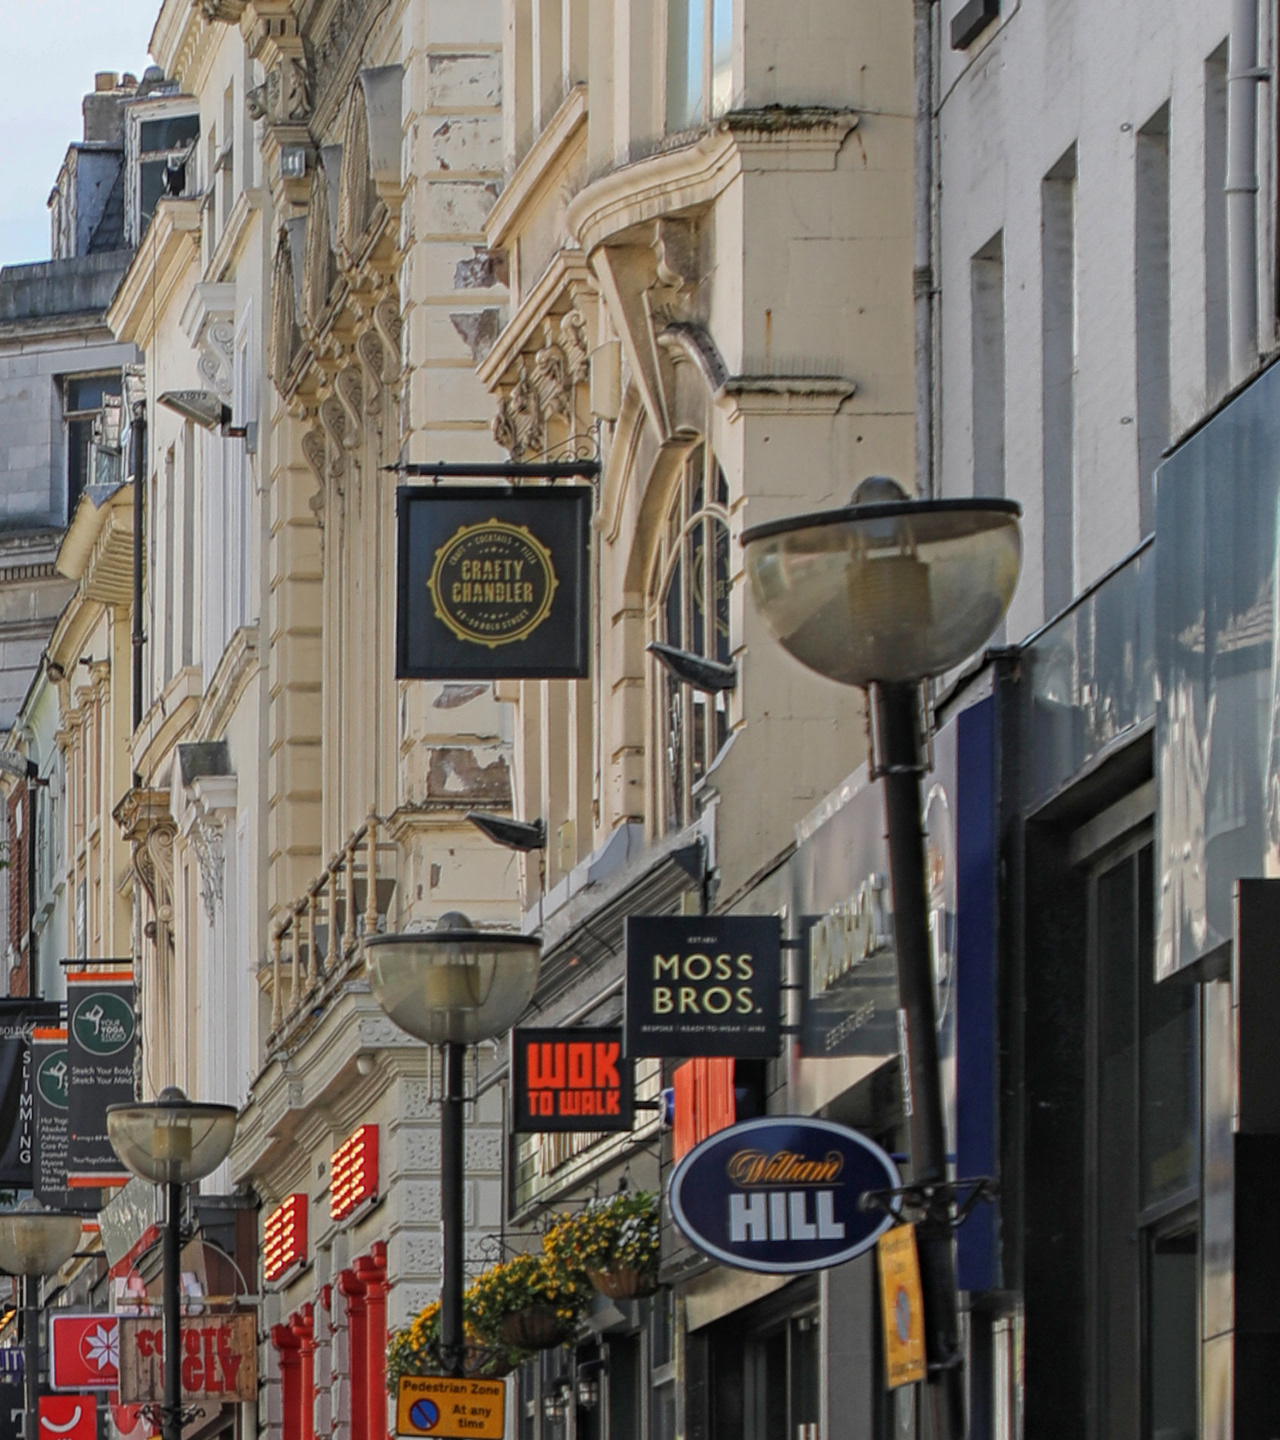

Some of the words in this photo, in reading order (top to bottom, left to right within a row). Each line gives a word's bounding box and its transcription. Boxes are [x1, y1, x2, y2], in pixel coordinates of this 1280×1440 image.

[461, 560, 524, 580] CRAFTY
[452, 582, 533, 603] CHANDLER
[653, 954, 754, 981] MOSS
[653, 987, 763, 1014] BROS.
[72, 1066, 95, 1075] Stretch
[96, 1066, 112, 1075] Your
[114, 1066, 133, 1076] Body
[527, 1042, 620, 1089] WOK
[72, 1076, 95, 1085] Stretch
[96, 1076, 112, 1085] Your
[114, 1076, 133, 1085] Mind
[20, 1050, 33, 1164] SLIMMING
[529, 1091, 553, 1116] TO
[559, 1090, 620, 1116] WALK
[727, 1148, 843, 1186] William
[730, 1190, 845, 1242] HILL
[135, 1326, 232, 1357] COOTE
[160, 1355, 243, 1392] GLY
[404, 1380, 467, 1393] Pedestrian
[471, 1384, 500, 1396] Zone
[454, 1404, 466, 1415] At
[471, 1407, 491, 1418] any
[459, 1418, 484, 1429] time
